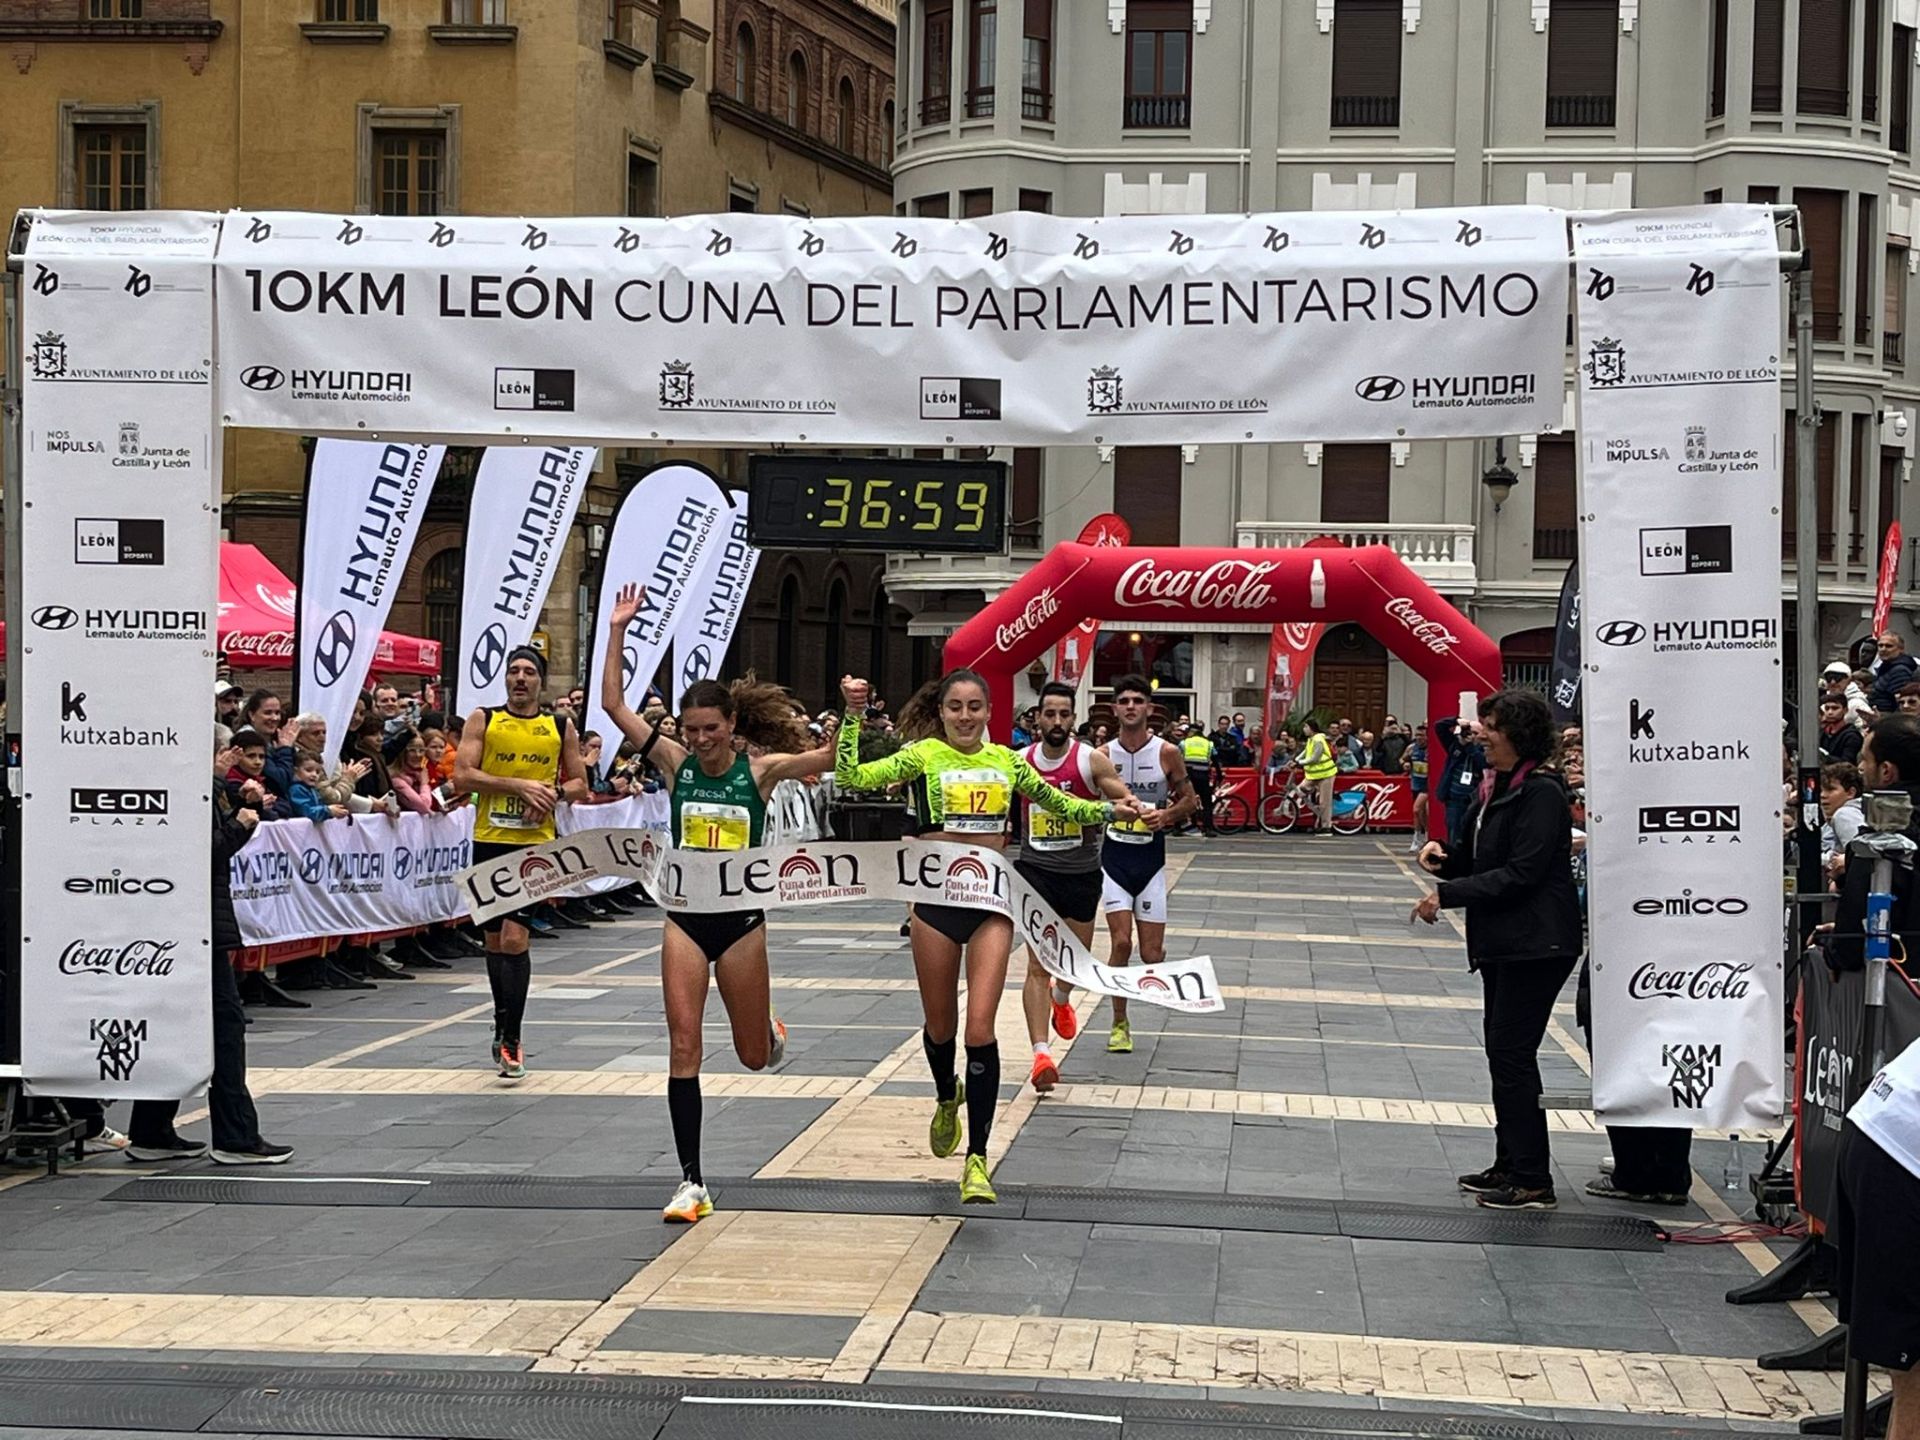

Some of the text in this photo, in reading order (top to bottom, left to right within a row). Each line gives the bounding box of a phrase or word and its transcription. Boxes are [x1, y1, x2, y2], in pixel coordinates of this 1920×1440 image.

[245, 265, 1539, 332] 10KM LEÓN CUNA DEL PARLAMENTARISMO
[70, 369, 209, 380] AYUNTAMIENTO DE LEÓN
[291, 369, 411, 392] HYUNDAI
[1629, 367, 1776, 384] AYUNTAMIENTO DE LEÓN
[1412, 375, 1535, 397] HYUNDAI
[696, 398, 836, 411] AYUNTAMIENTO DE LEÓN
[925, 390, 957, 403] LEÓN
[1126, 398, 1268, 411] AYUNTAMIENTO DE LEÓN
[1412, 394, 1535, 408] Lemauto Automoción
[47, 431, 70, 439] NOS
[142, 447, 190, 457] Junta de
[1606, 440, 1631, 449] NOS
[1709, 449, 1758, 461] Junta de
[112, 458, 190, 470] Castilla y León
[1678, 461, 1758, 474] Castilla y León
[340, 444, 411, 602] HYUND
[494, 446, 571, 616] HYUNDAI
[81, 533, 115, 546] LEÓN
[517, 449, 584, 621] Lemauto Automoción
[1646, 542, 1682, 557] LEÓN
[367, 526, 403, 607] Lemauto
[627, 497, 708, 641] HYUNDAI
[649, 506, 719, 646] Lemauto Automoción
[1115, 558, 1282, 609] Coca-Cola
[85, 609, 206, 630] HYUNDAI
[85, 630, 206, 640] Lemauto Automoción
[1654, 619, 1777, 642] HYUNDAI
[1654, 639, 1777, 652] Lemauto Automoción
[61, 725, 178, 746] kutxabank
[1629, 740, 1750, 763] kutxabank
[75, 793, 165, 810] LEON
[970, 791, 988, 813] 12
[70, 816, 168, 825] PLAZA
[1046, 819, 1064, 836] 39
[1643, 810, 1737, 828] LEON
[708, 825, 720, 848] 11
[1638, 834, 1741, 844] PLAZA
[65, 869, 174, 894] emico
[779, 877, 822, 890] Cuna del
[945, 879, 988, 893] Cuna del
[780, 886, 867, 902] Parlamentarismo
[1632, 888, 1748, 915] emico
[58, 939, 179, 976] Coca-Cola
[1629, 961, 1754, 1000] Coca-Cola
